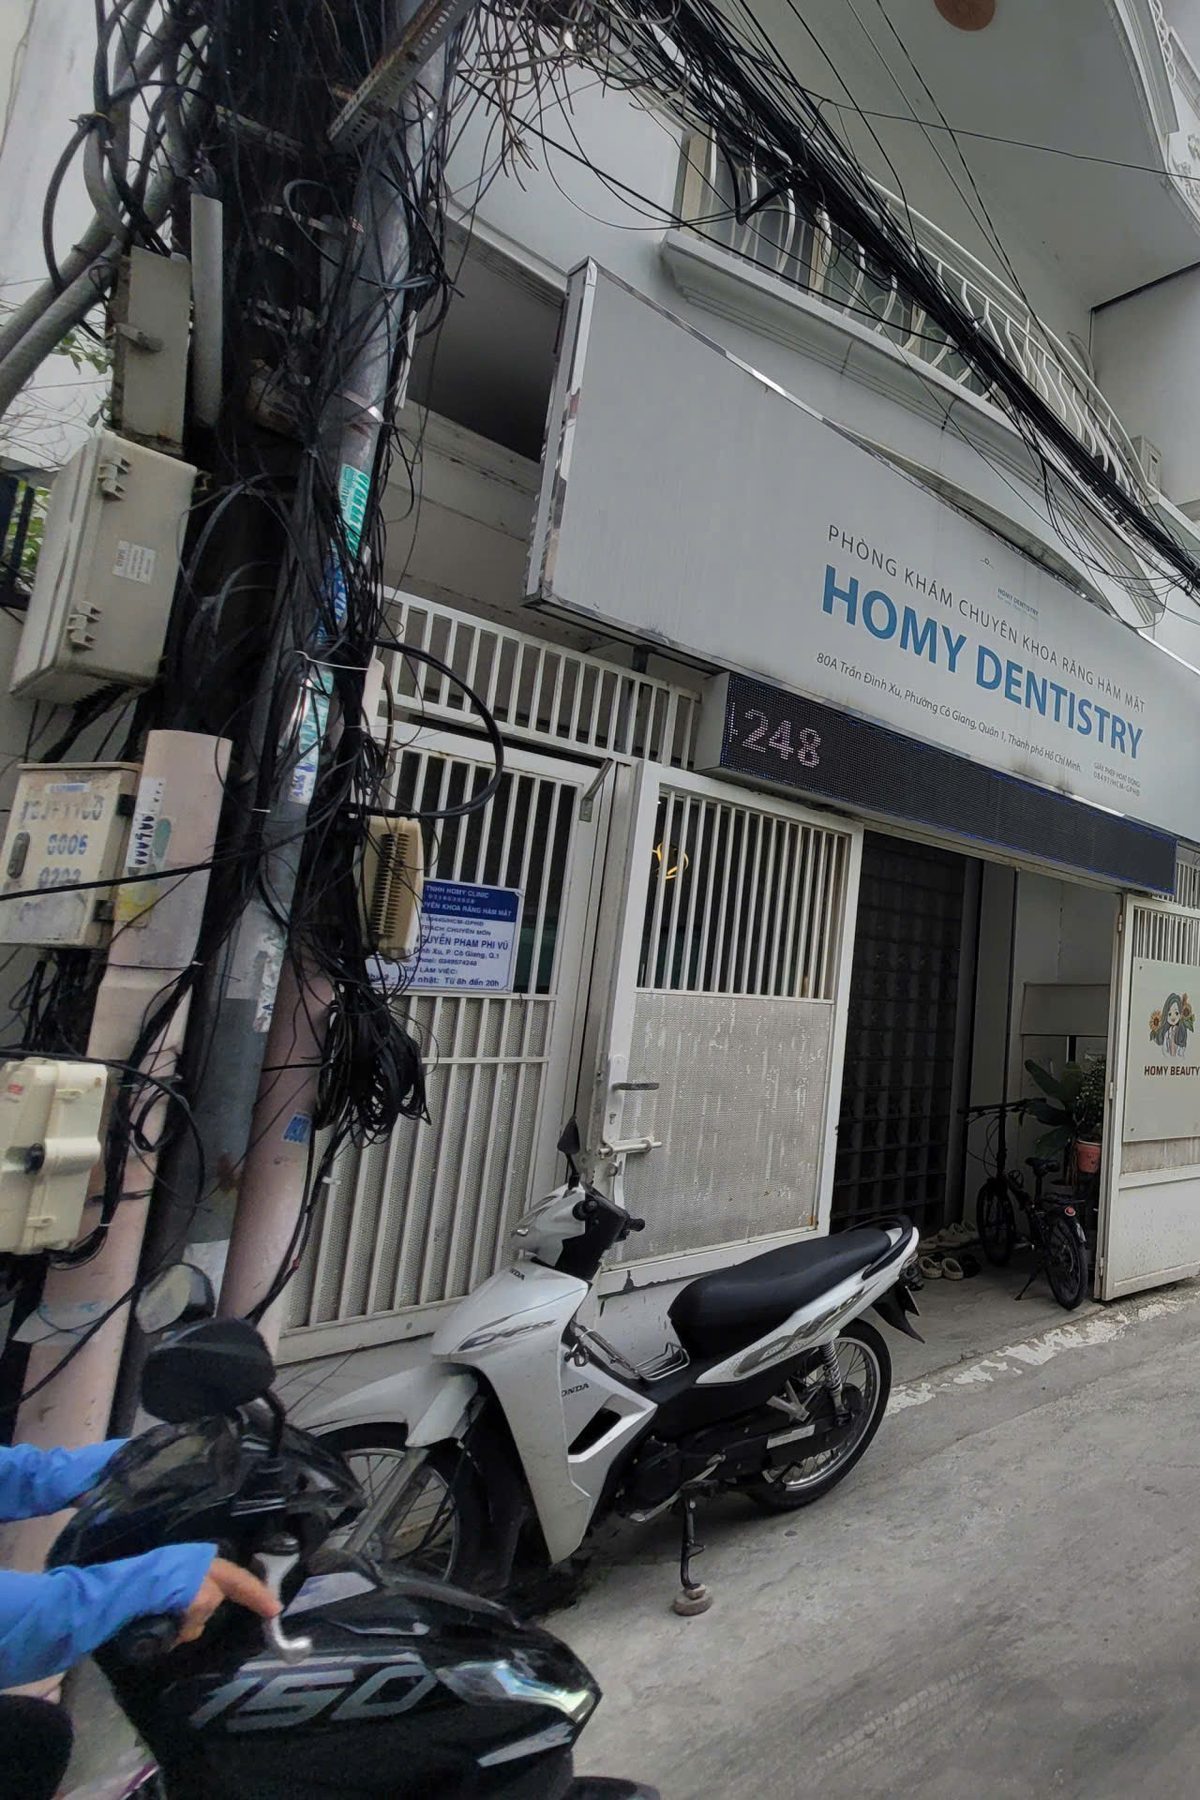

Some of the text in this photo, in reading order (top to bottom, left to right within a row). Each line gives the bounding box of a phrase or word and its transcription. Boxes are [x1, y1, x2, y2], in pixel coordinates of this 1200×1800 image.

[828, 524, 898, 577] PHÒNG
[904, 567, 953, 609] KHÁM
[958, 599, 1017, 645] CHUYÊN
[1022, 634, 1058, 667] KHOA
[1062, 656, 1094, 686] RĂNG
[1097, 677, 1121, 701] HÀM
[816, 652, 838, 671] 80A
[888, 682, 903, 699] Xu,
[939, 705, 951, 718] Cô
[951, 710, 977, 731] Giang,
[822, 564, 1144, 760] HOMY DENTISTRY
[1144, 1065, 1200, 1077] HOMY BEAUTY
[560, 1382, 590, 1398] ONDA
[189, 1661, 438, 1733] 150
